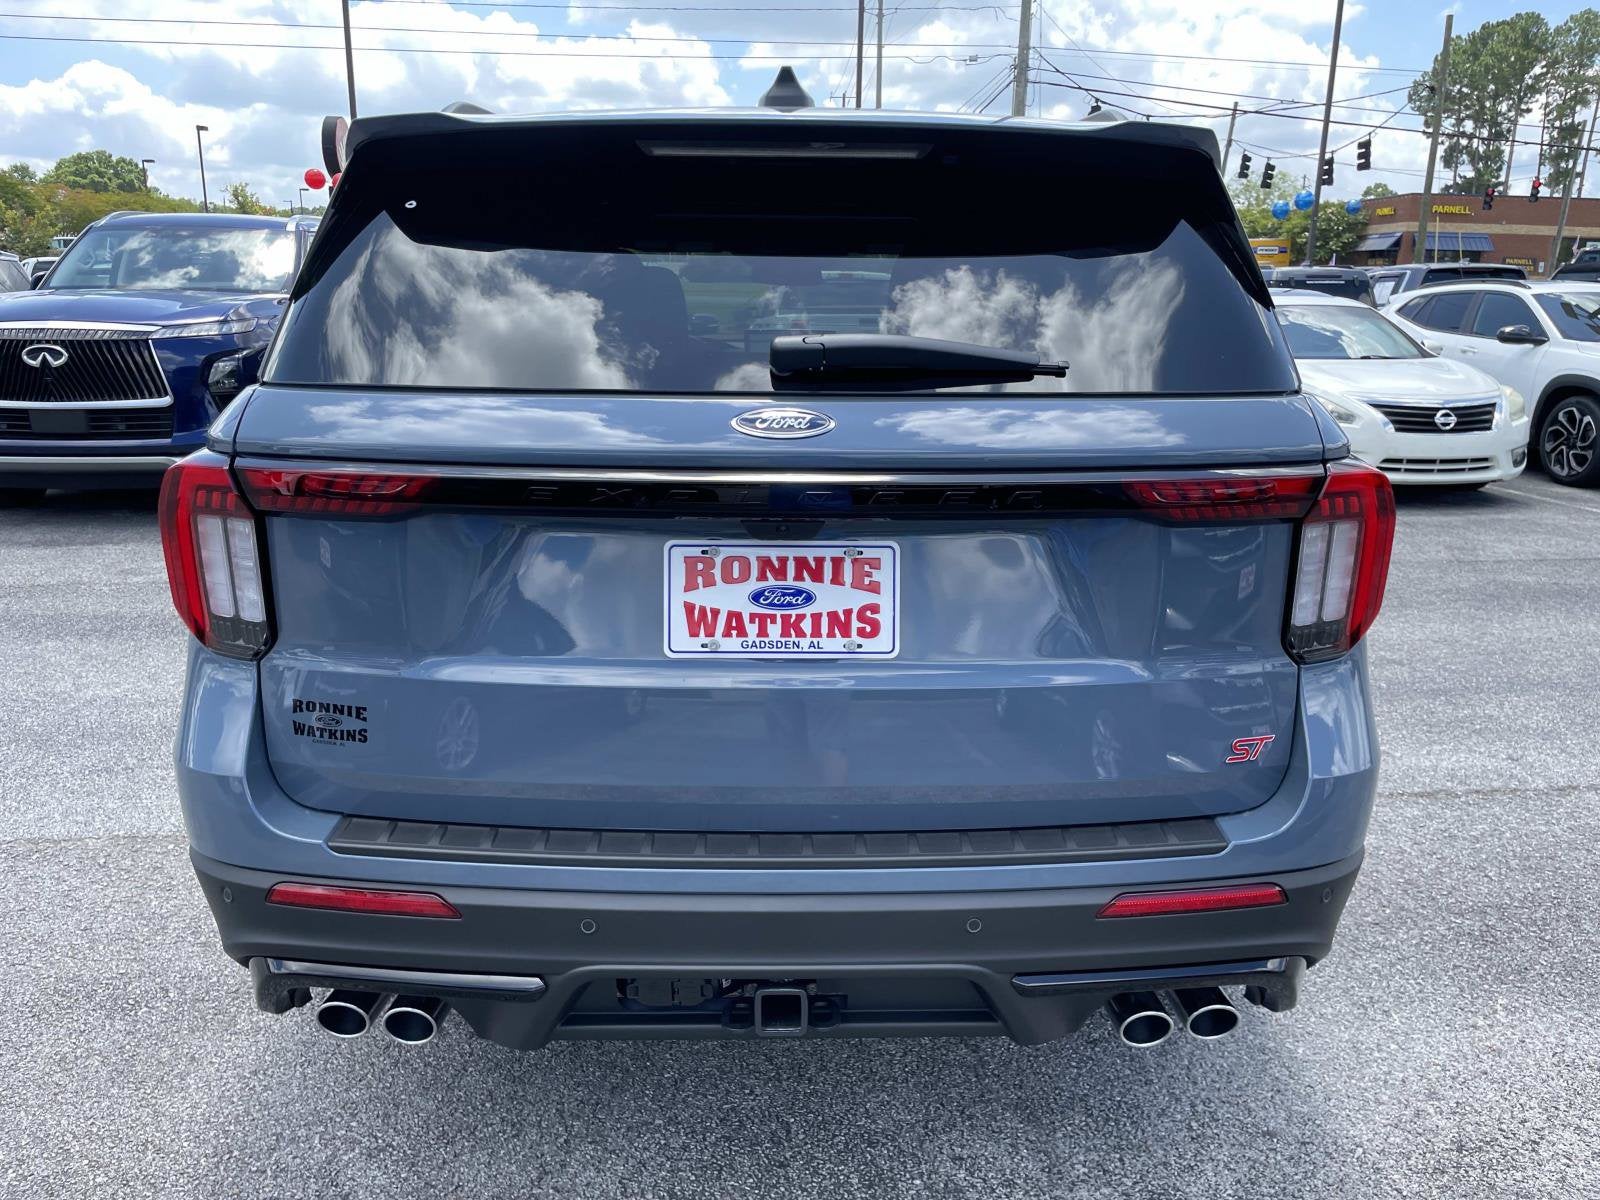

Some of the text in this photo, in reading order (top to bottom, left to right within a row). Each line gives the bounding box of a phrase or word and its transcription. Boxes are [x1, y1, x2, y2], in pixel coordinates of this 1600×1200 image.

[1432, 204, 1471, 214] PARNELL
[755, 412, 811, 429] Ford
[519, 485, 1046, 507] EXPLORER
[683, 555, 882, 595] RONNIE
[759, 588, 808, 605] Ford
[683, 600, 882, 639] WATKINS
[740, 640, 824, 650] GADSDEN, AL
[292, 699, 367, 722] RONNIE
[292, 720, 368, 743] WATKINS
[1226, 734, 1276, 763] ST
